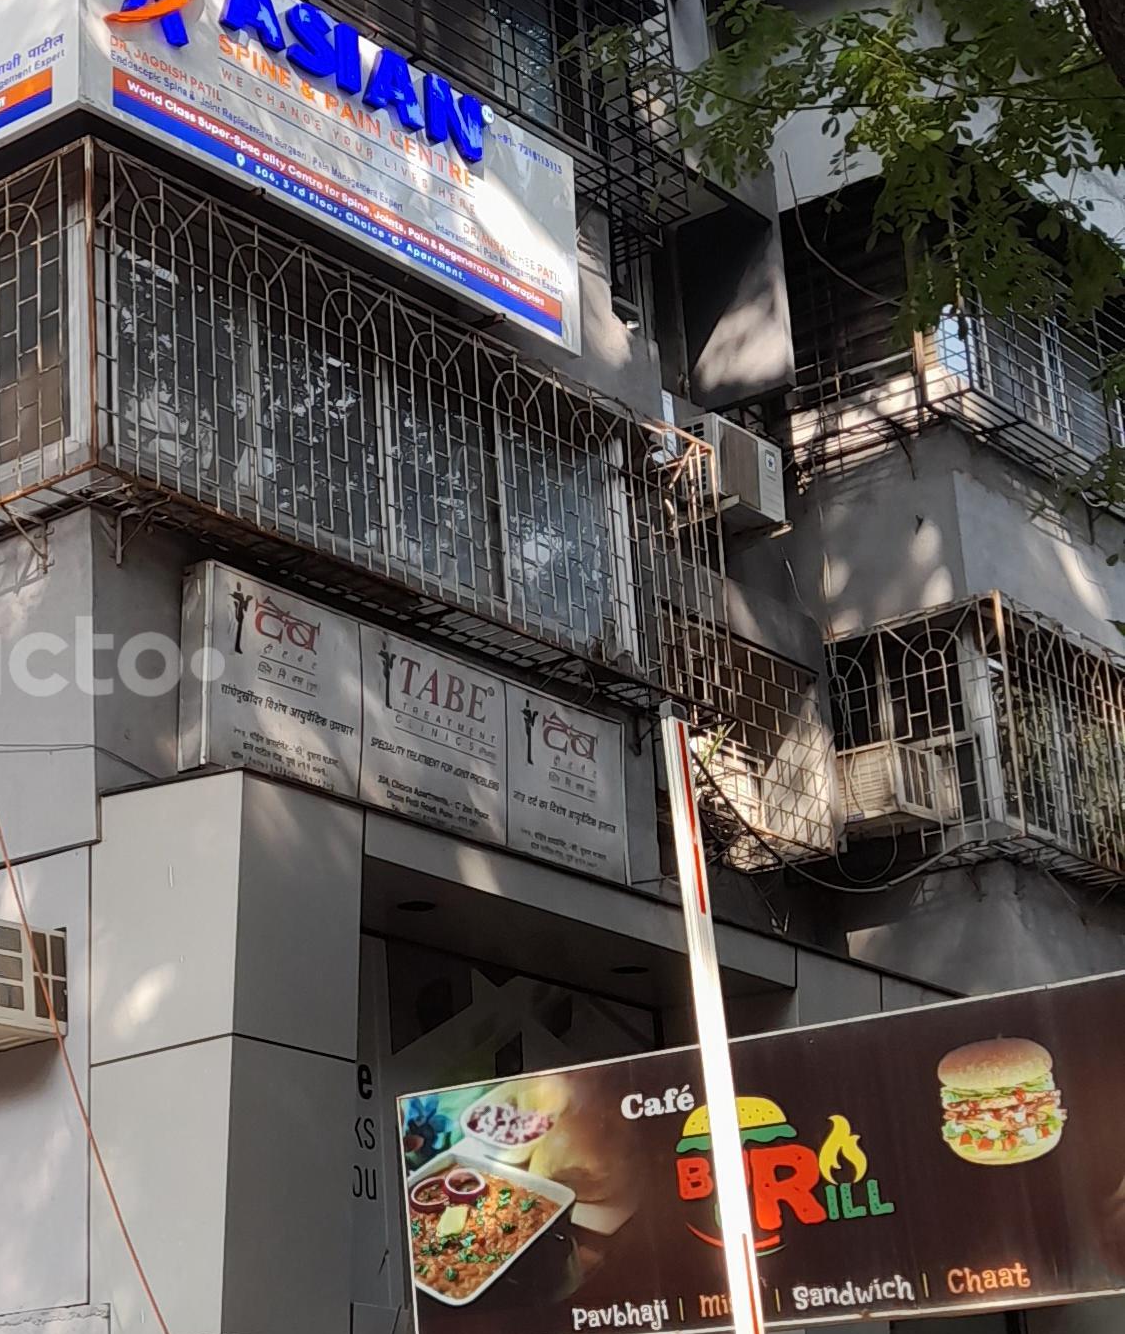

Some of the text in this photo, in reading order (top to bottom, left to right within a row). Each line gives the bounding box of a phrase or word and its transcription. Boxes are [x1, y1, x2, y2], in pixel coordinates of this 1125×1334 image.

[218, 33, 291, 87] SPINE
[325, 91, 382, 138] PAIN
[388, 129, 476, 190] CENTRE
[221, 67, 245, 88] WE
[332, 129, 374, 160] YOUR
[126, 78, 163, 107] World
[164, 98, 197, 123] Class
[325, 180, 341, 200] for
[407, 227, 430, 246] Pain
[345, 211, 385, 239] Choice
[399, 656, 488, 724] TABE
[619, 1083, 696, 1121] Café
[571, 1297, 669, 1332] Pavbhaji
[792, 1272, 916, 1311] Sandwich
[946, 1260, 1033, 1296] Chaat
